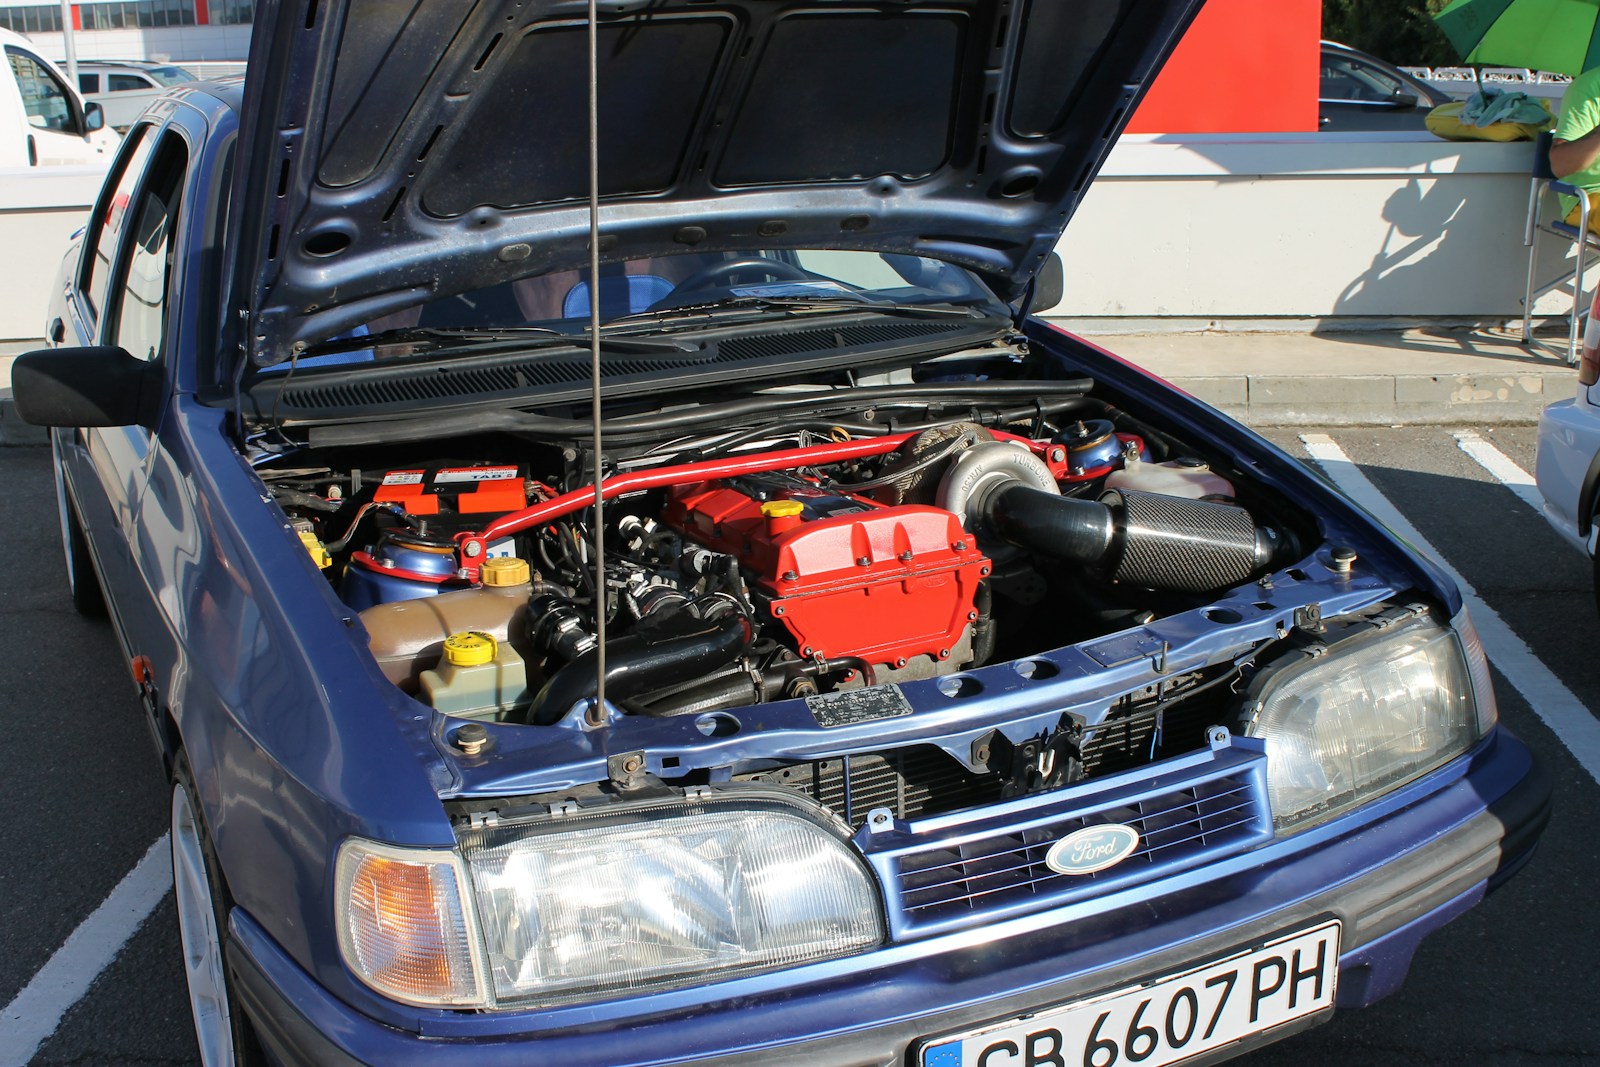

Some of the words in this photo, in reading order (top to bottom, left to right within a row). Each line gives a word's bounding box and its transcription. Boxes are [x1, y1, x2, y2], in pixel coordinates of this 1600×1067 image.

[1071, 835, 1117, 864] Ford
[1083, 969, 1238, 1067] 6607
[1249, 938, 1327, 1023] PH
